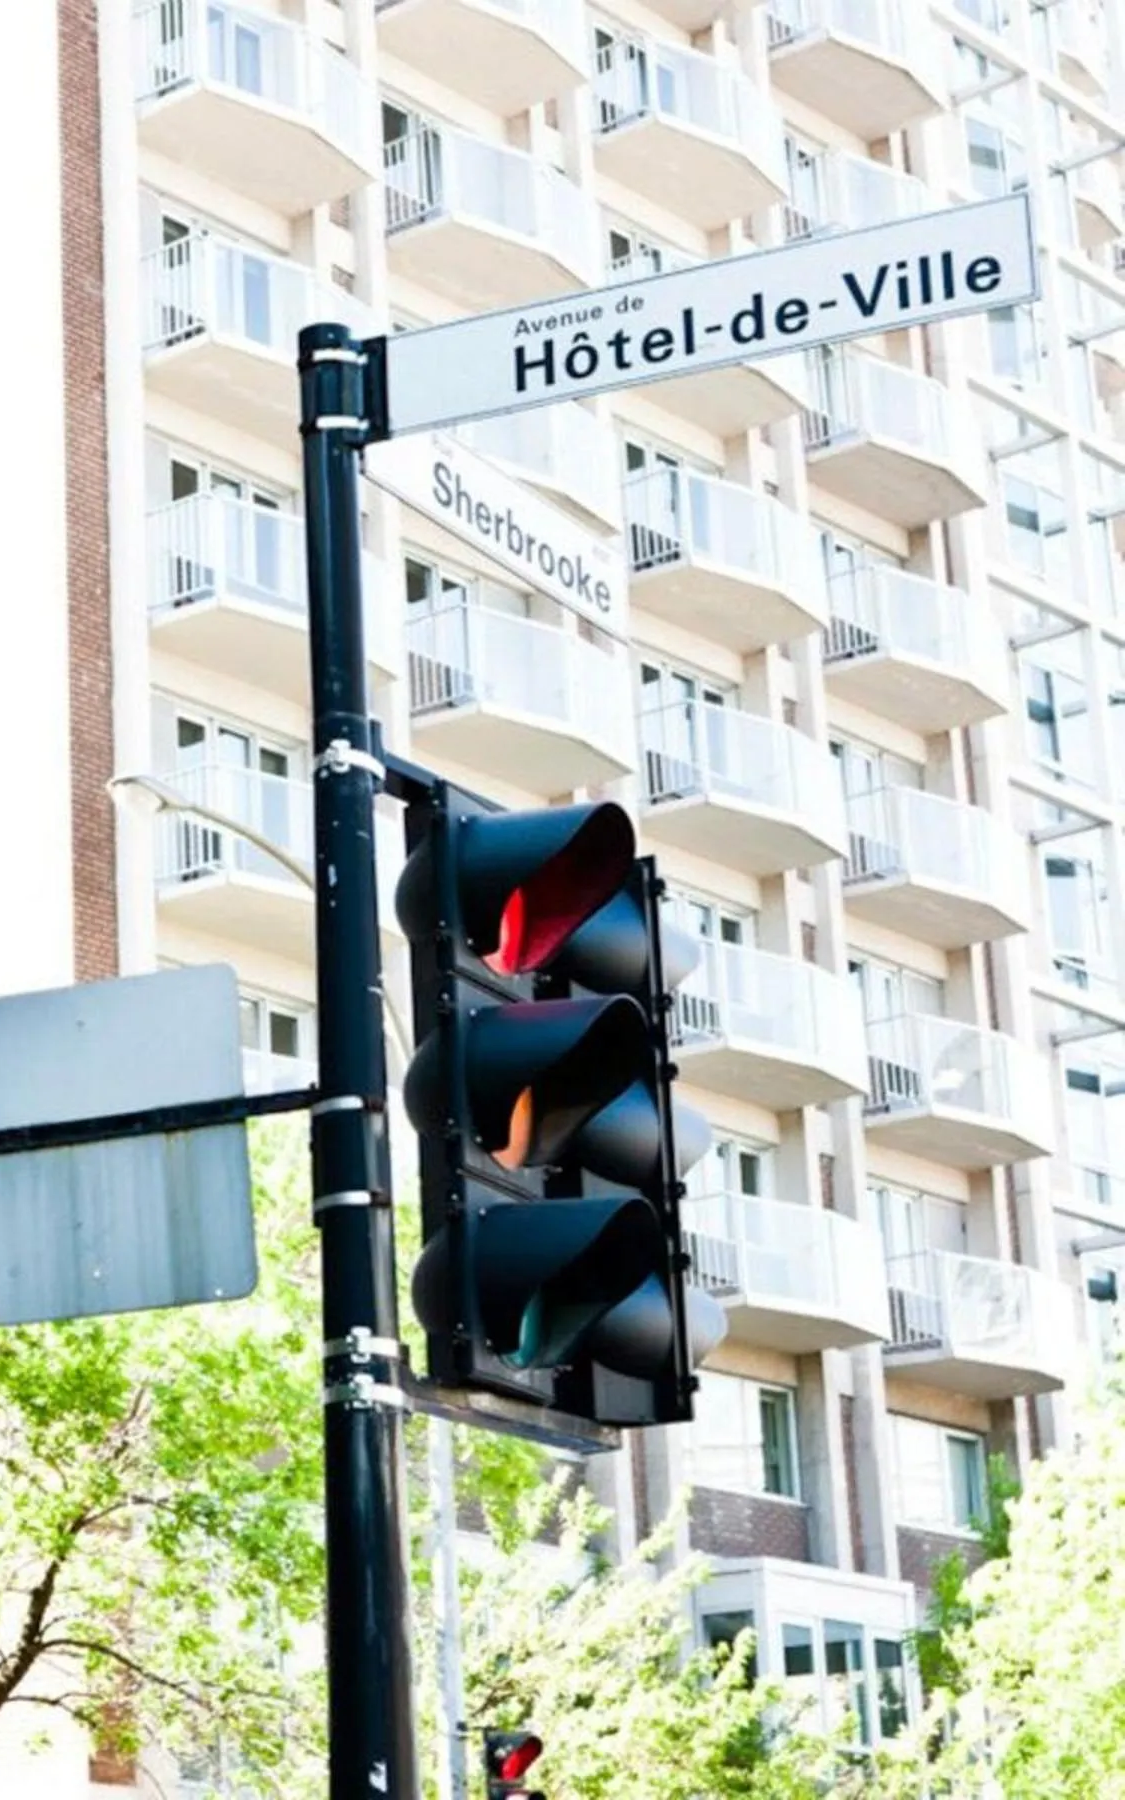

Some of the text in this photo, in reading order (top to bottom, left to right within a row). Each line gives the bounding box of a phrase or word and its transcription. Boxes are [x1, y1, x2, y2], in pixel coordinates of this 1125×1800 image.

[514, 250, 1002, 392] Hôtel-de-Ville
[515, 294, 644, 337] Avenue de
[432, 461, 612, 613] Sherbrooke
